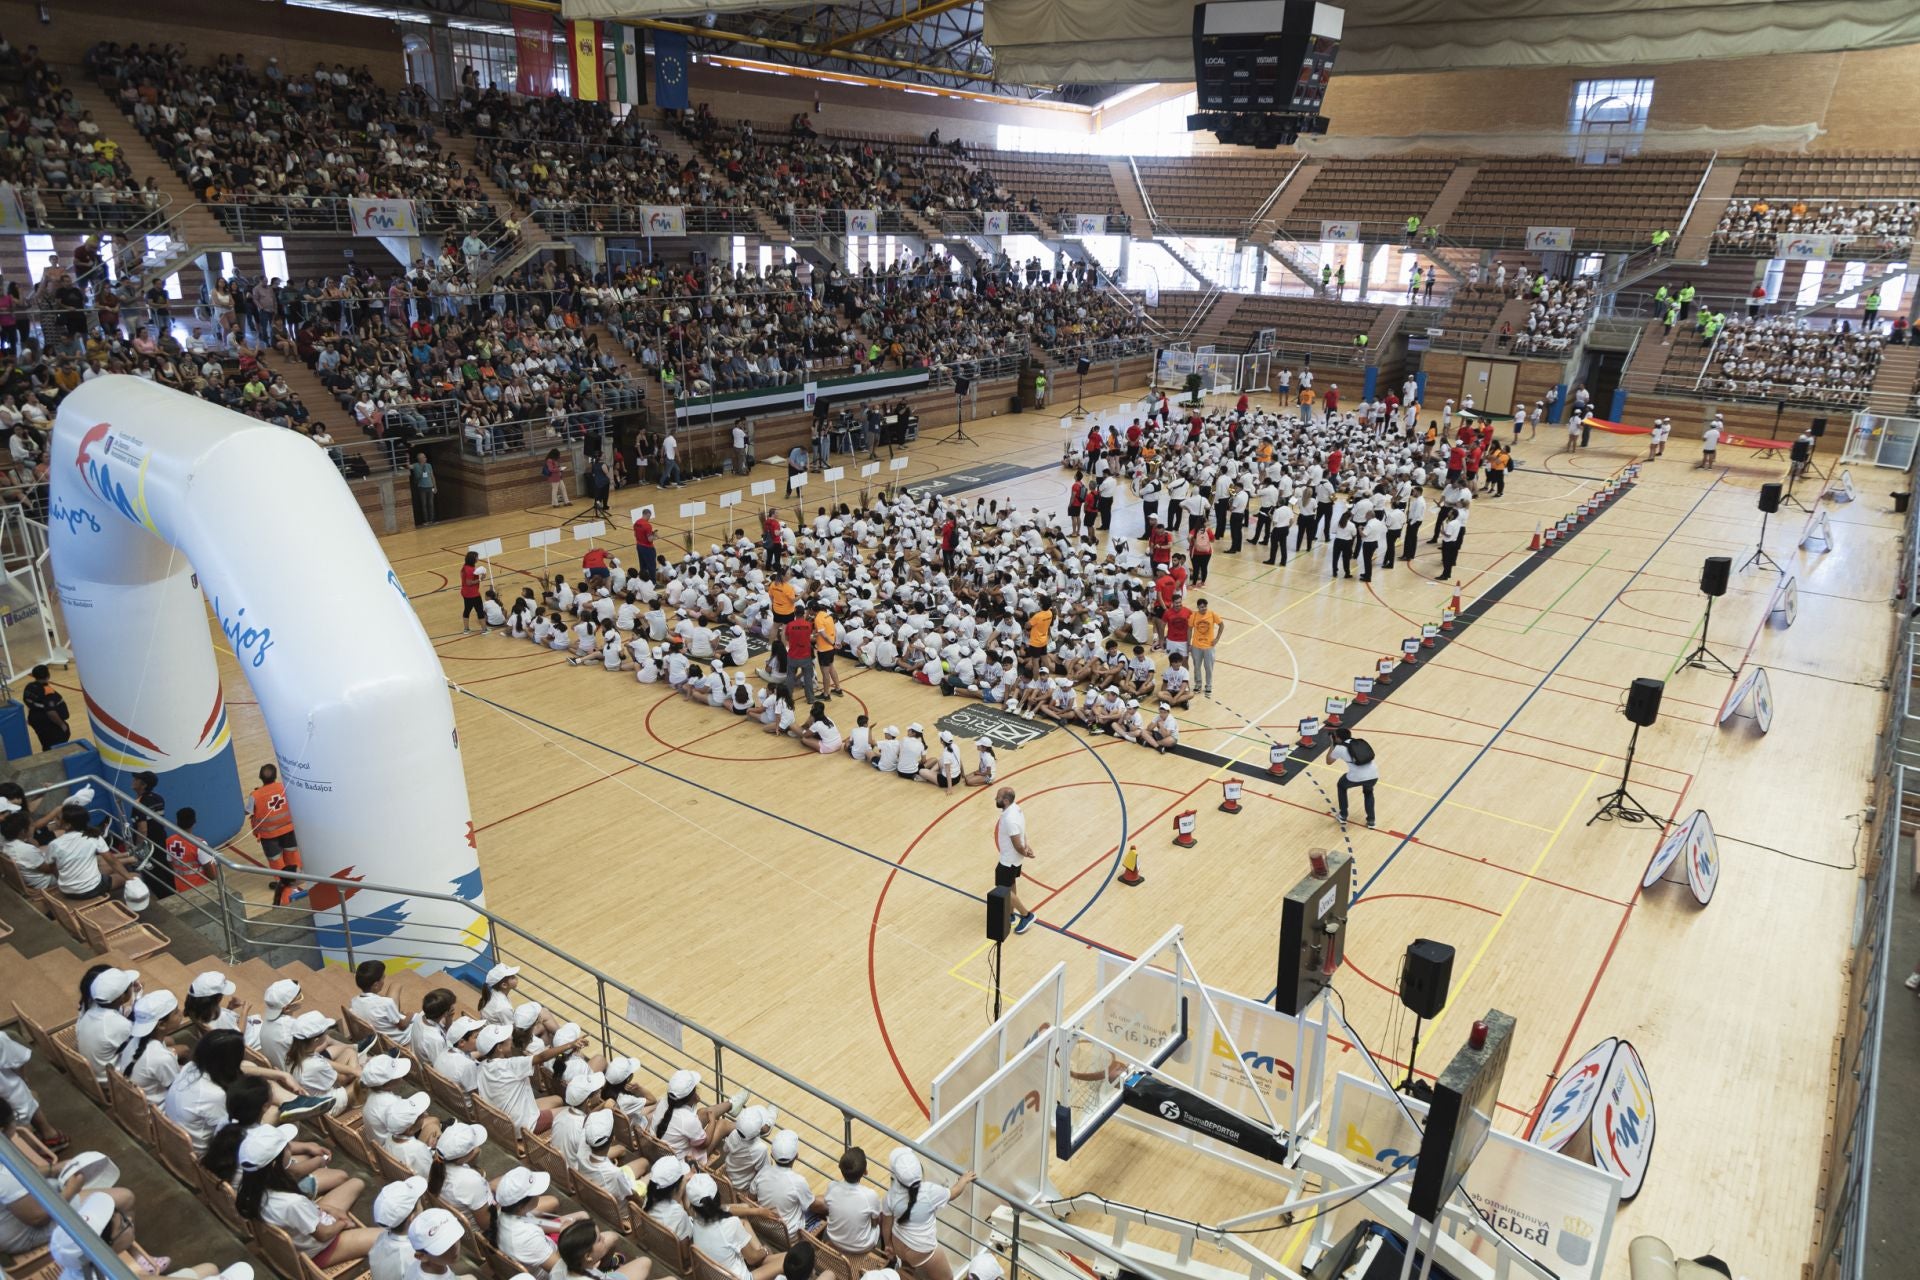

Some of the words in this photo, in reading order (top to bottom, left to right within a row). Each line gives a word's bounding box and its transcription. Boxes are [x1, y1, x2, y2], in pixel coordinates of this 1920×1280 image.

[1205, 57, 1226, 65] LOCAL
[1256, 56, 1278, 64] VISITANTE
[304, 782, 333, 793] Badajoz
